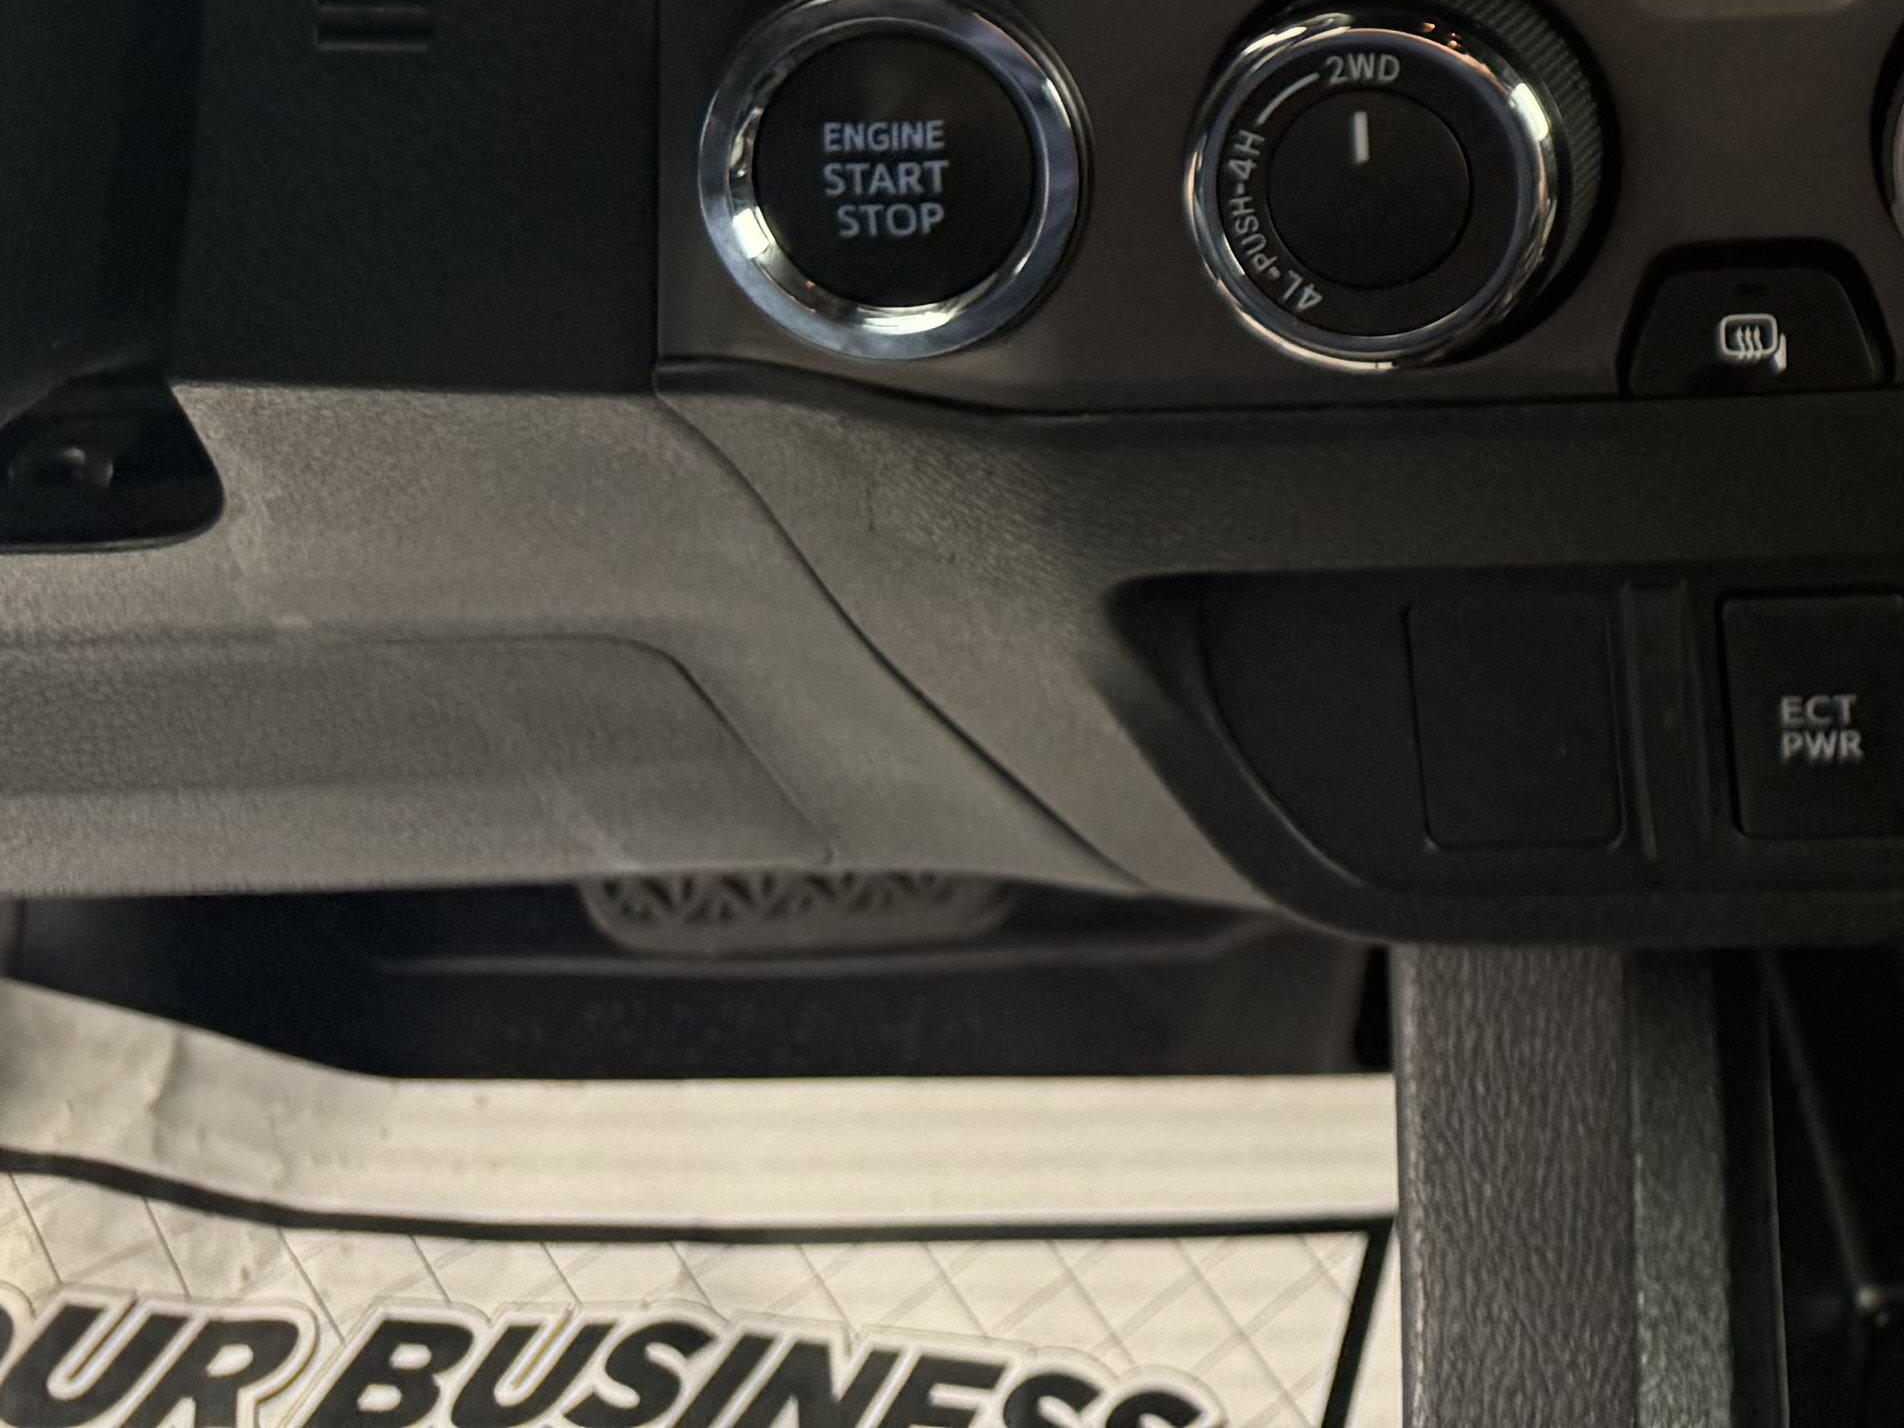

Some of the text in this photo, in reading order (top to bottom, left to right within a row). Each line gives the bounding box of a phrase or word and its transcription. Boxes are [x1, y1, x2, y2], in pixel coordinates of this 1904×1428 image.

[1325, 54, 1400, 86] 2WD
[822, 120, 945, 153] ENGINE
[823, 160, 949, 198] START
[837, 202, 948, 238] STOP
[1780, 695, 1857, 727] ECT
[1780, 730, 1864, 762] PWR
